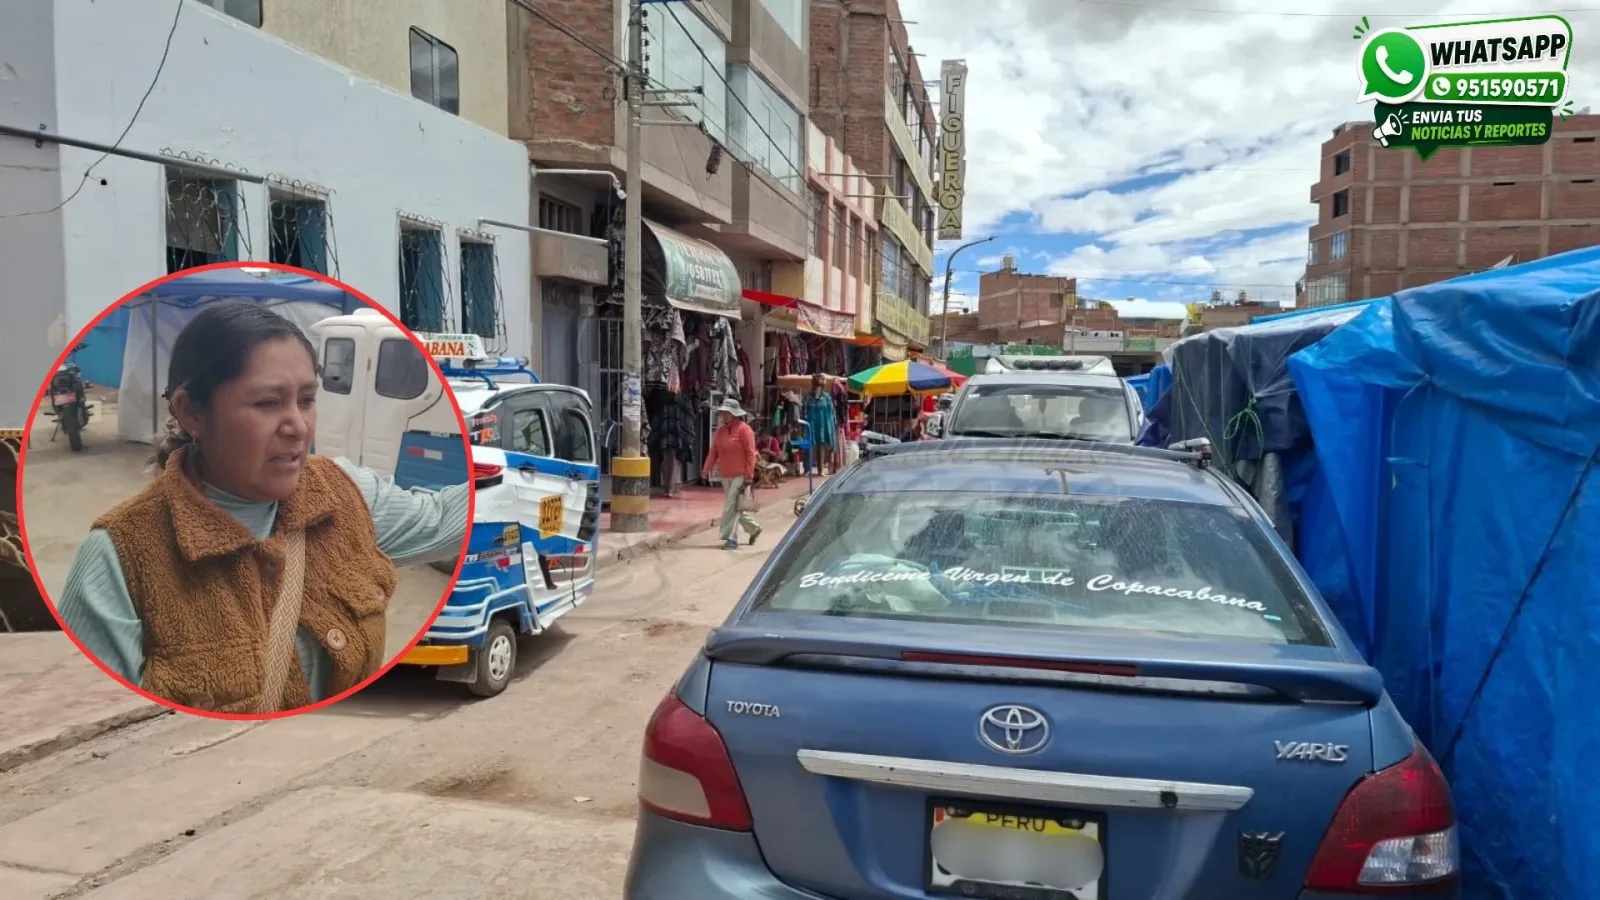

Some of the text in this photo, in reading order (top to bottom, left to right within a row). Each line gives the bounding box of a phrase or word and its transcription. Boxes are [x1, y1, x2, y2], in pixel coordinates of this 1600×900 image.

[939, 74, 963, 230] FIGUEROA
[799, 566, 1267, 612] Bendiceme Virgen de Copacabana
[726, 700, 780, 718] TOYOTA
